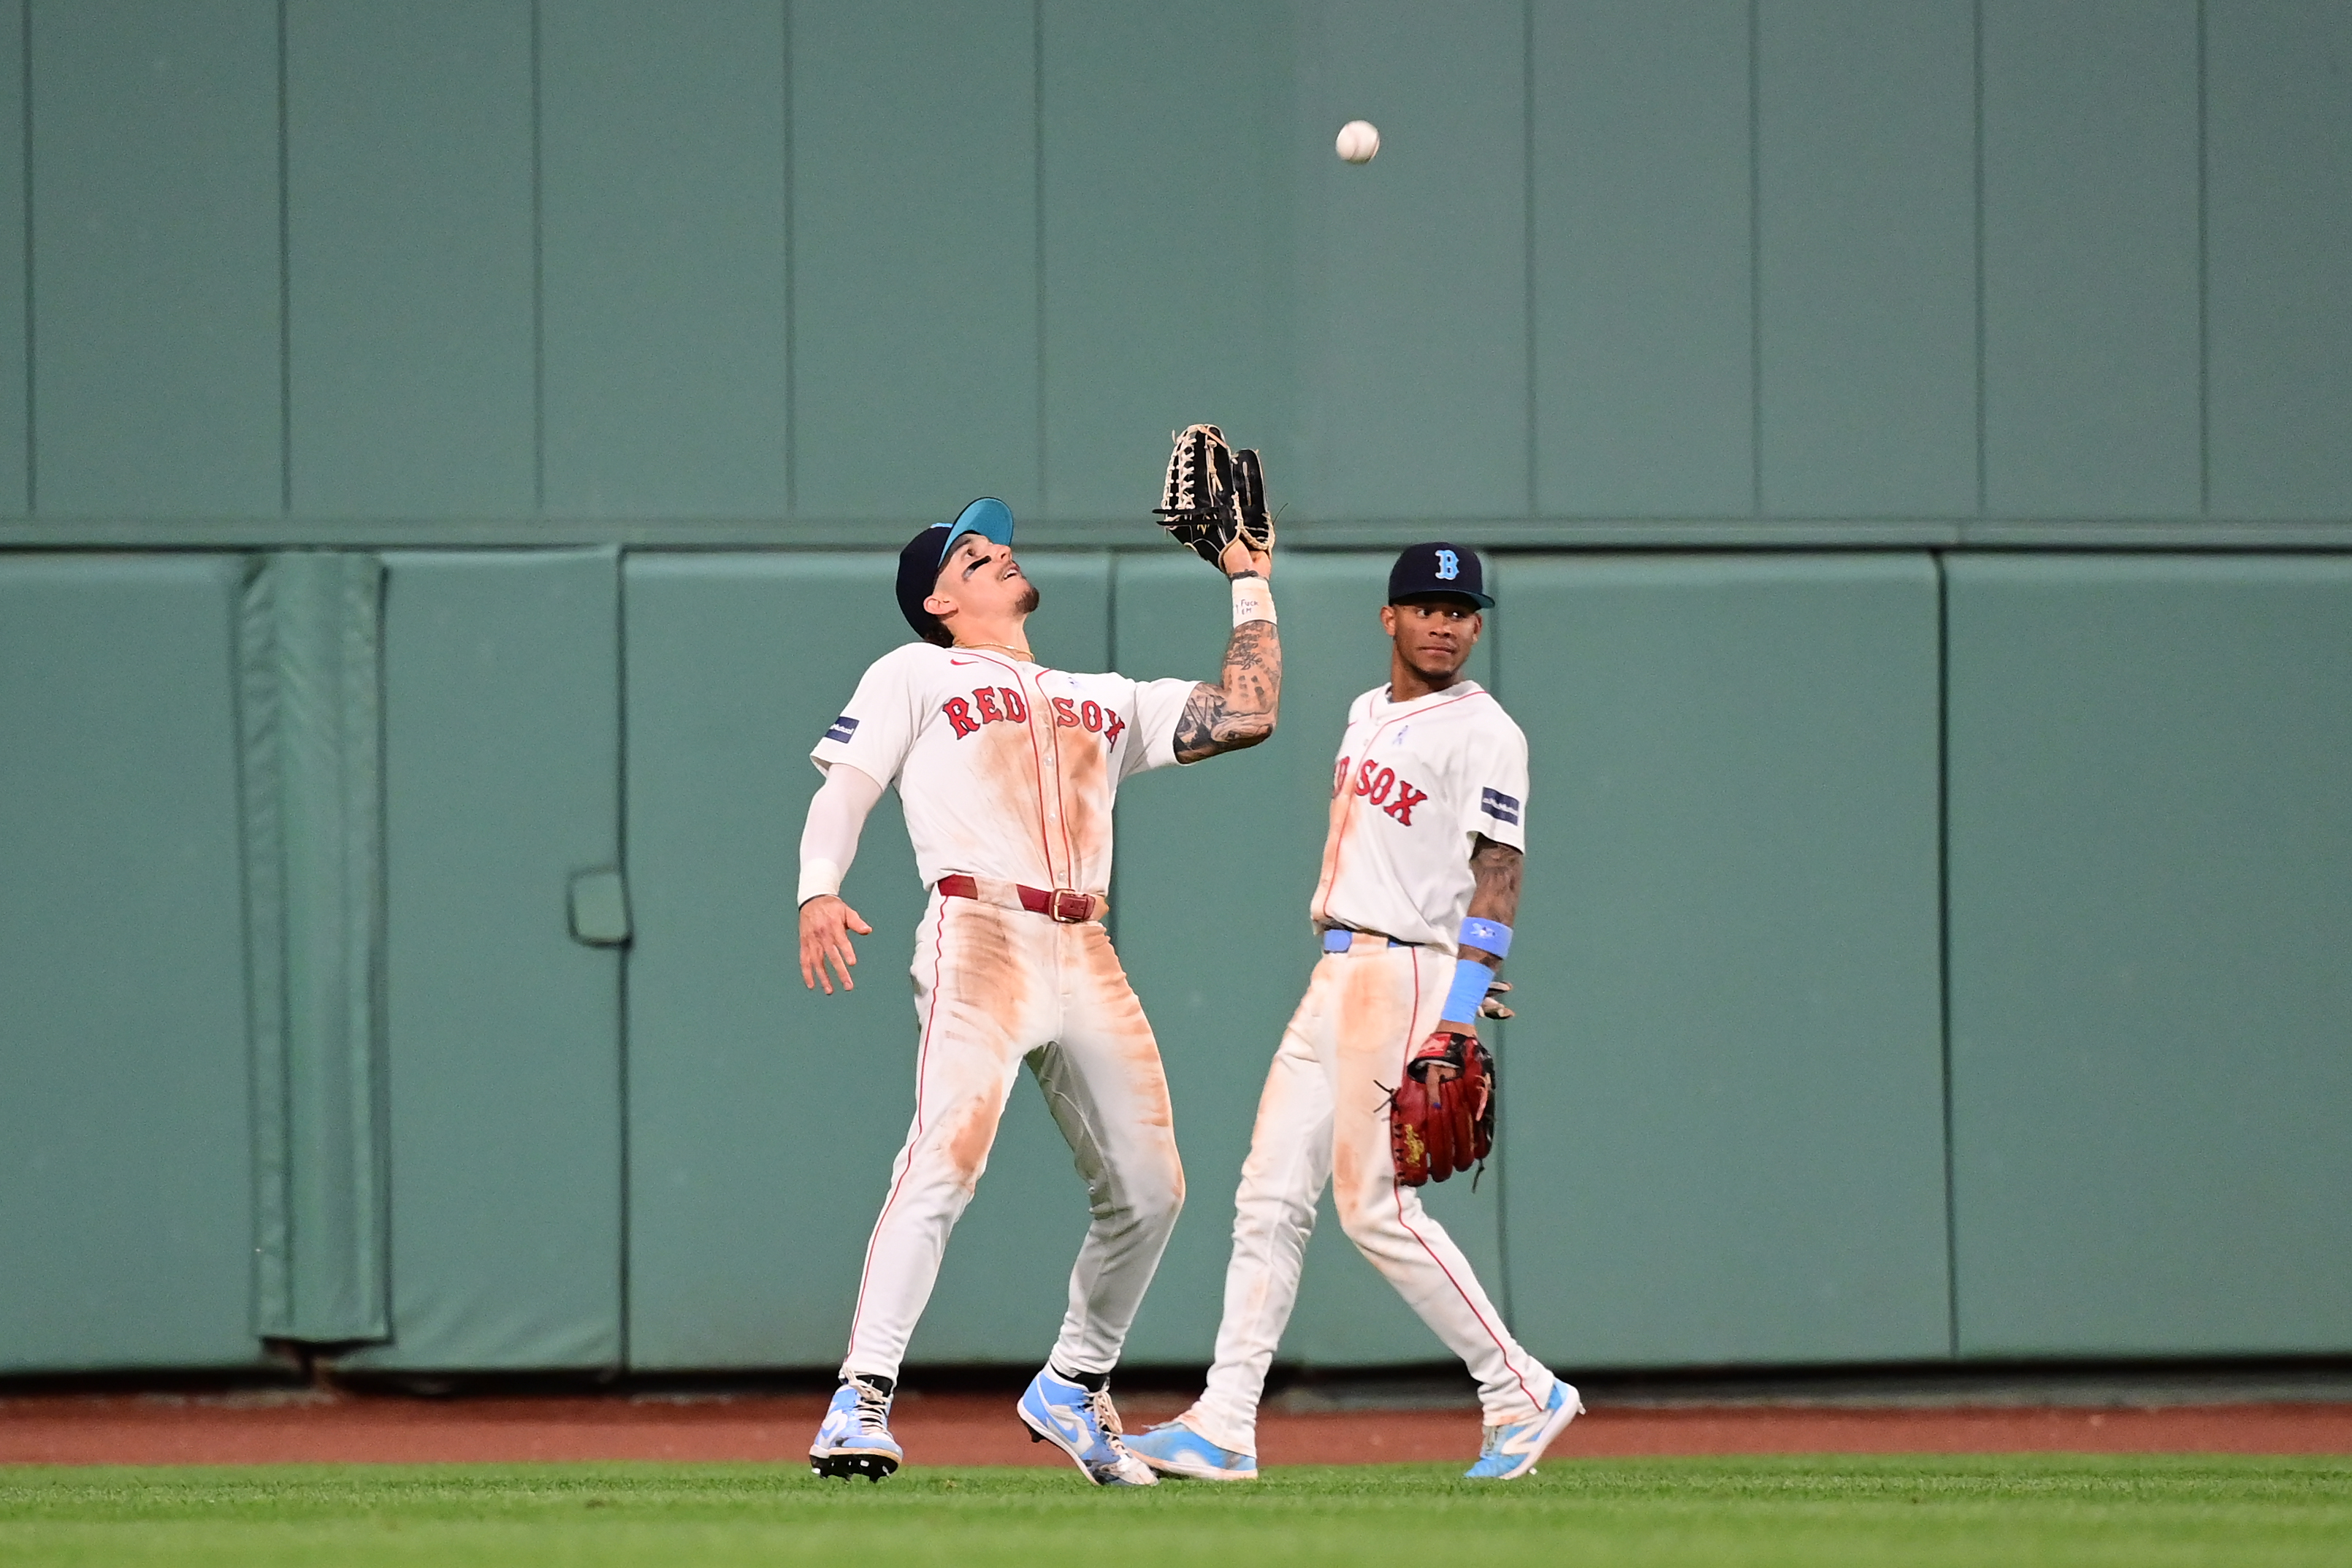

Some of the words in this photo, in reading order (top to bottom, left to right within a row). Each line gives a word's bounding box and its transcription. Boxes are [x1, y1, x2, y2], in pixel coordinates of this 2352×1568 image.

[1435, 549, 1459, 581] B
[942, 686, 1027, 741] RED
[1052, 697, 1126, 754] SOX
[1354, 759, 1428, 827] SOX
